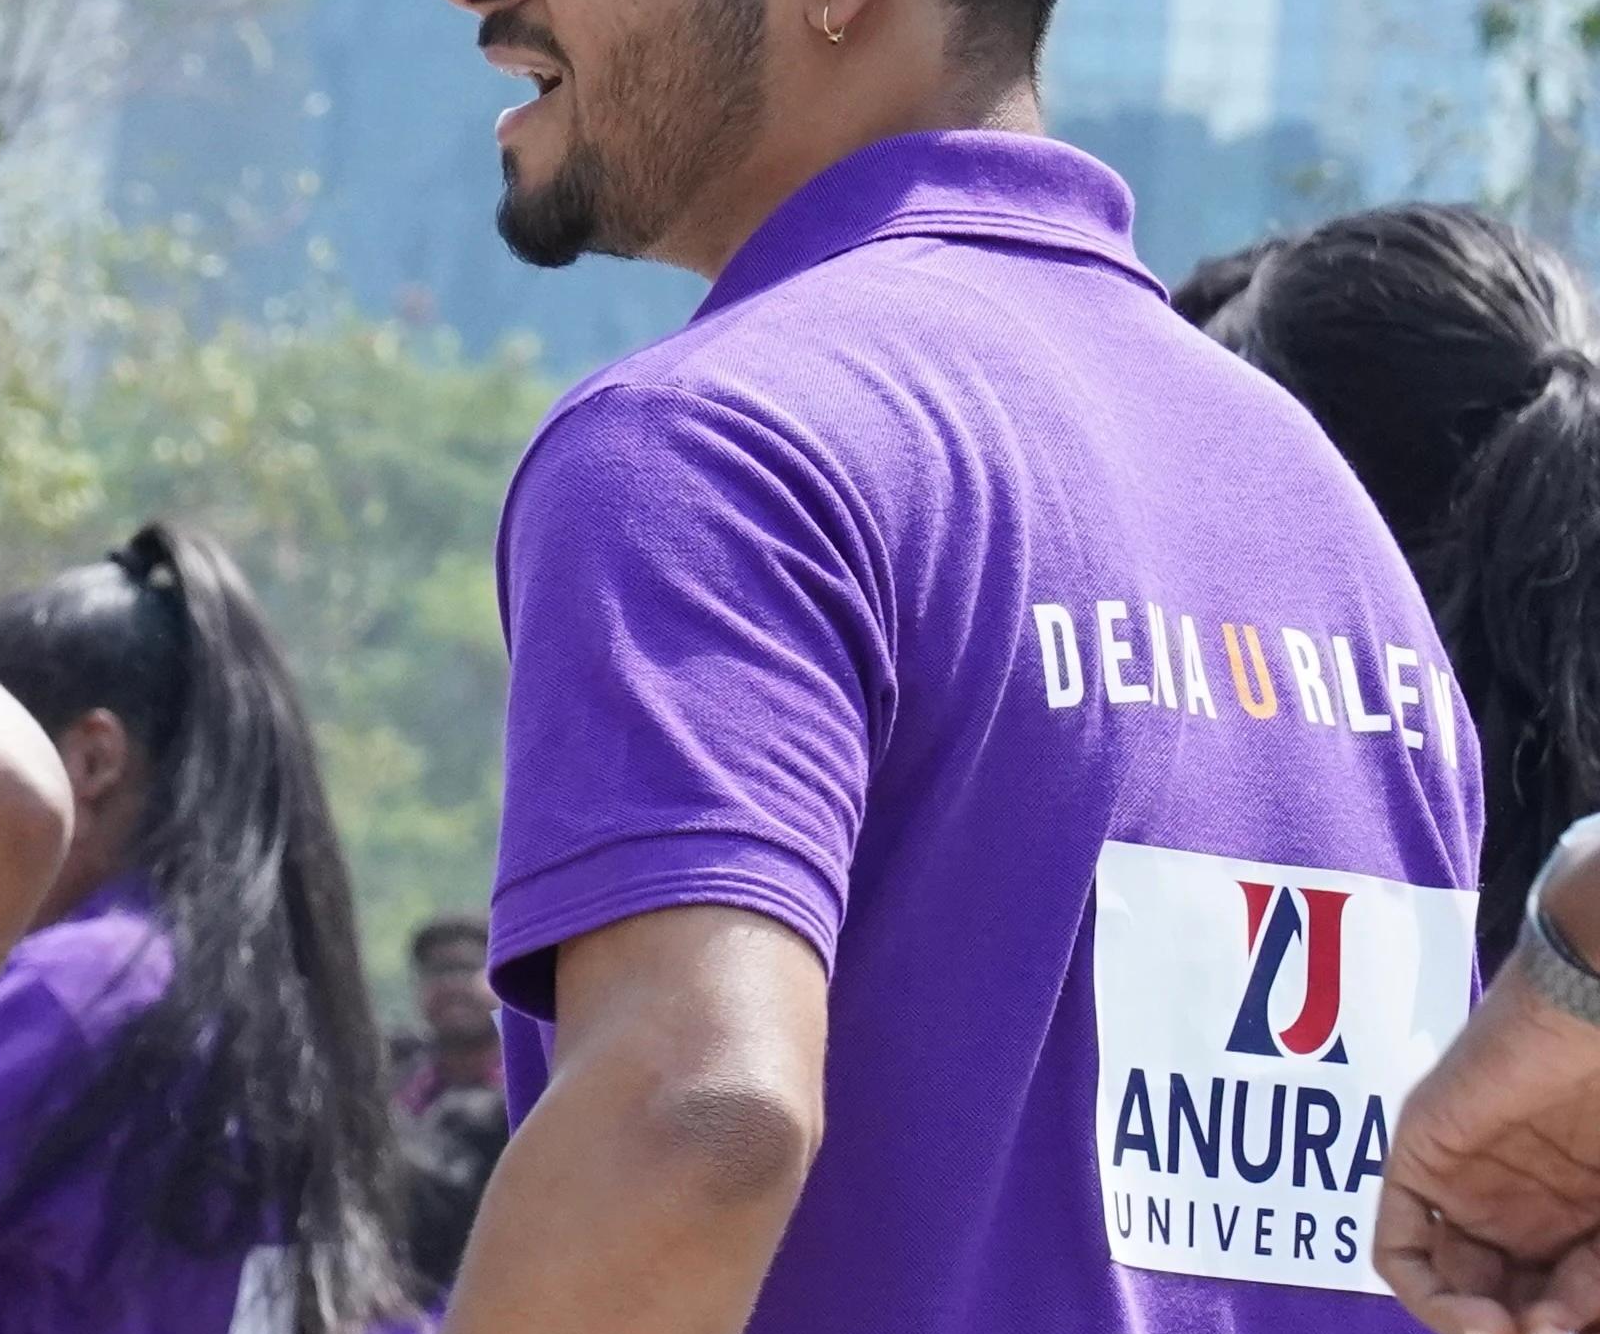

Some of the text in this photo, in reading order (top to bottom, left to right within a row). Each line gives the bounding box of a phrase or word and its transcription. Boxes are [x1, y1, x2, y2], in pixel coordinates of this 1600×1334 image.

[1033, 600, 1457, 770] DENAURLEN
[1112, 1067, 1390, 1193] ANURA
[1114, 1190, 1357, 1264] UNIVERS
